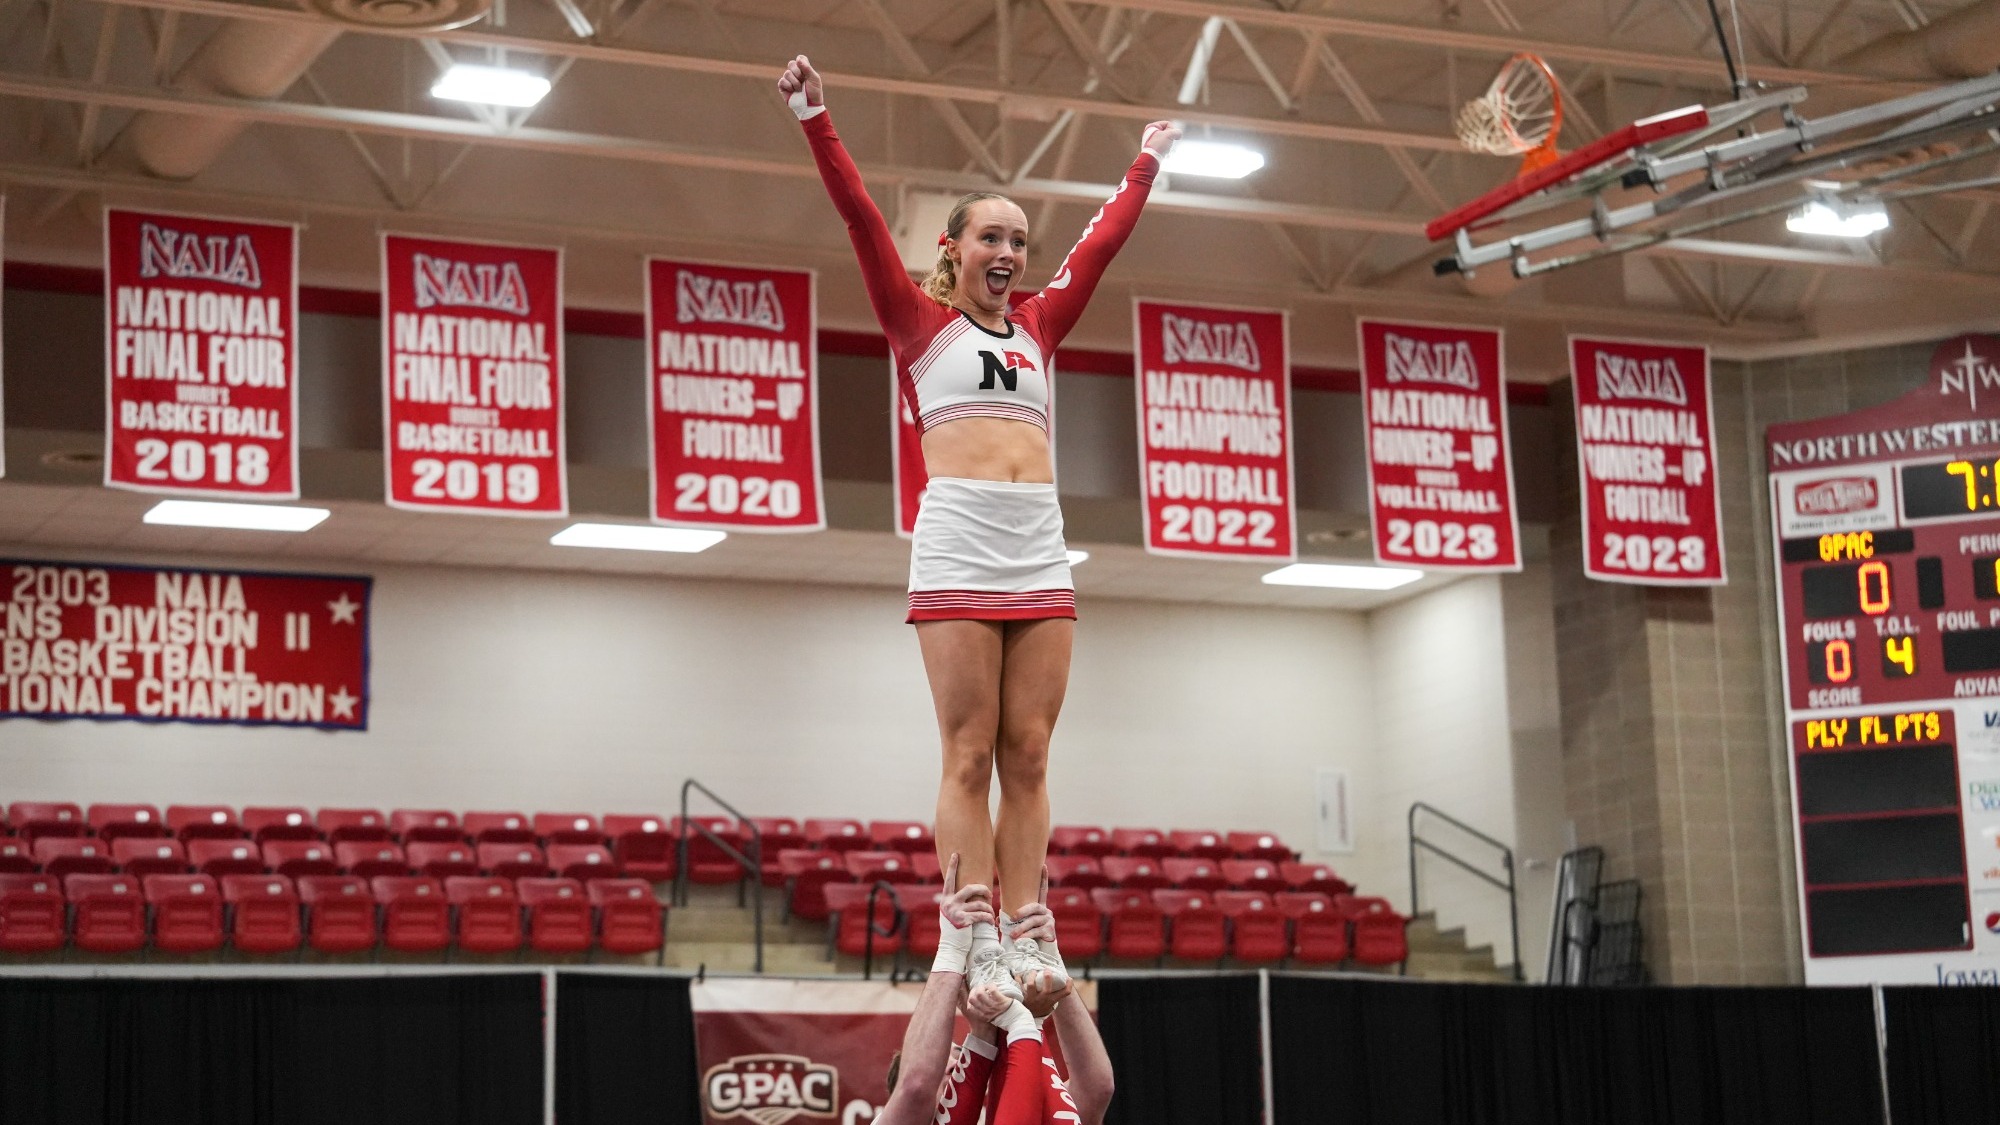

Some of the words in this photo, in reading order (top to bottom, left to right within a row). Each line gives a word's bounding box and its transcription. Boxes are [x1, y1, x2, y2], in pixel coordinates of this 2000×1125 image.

[140, 221, 262, 289] NAIA
[413, 253, 530, 316] NAIA
[676, 269, 785, 332] NAIA
[117, 286, 285, 337] NATIONAL
[117, 328, 204, 382] FINAL
[208, 334, 286, 388] FOUR
[394, 312, 551, 361] NATIONAL
[659, 330, 805, 378] NATIONAL
[1162, 312, 1261, 372] NAIA
[394, 352, 478, 406] FINAL
[479, 358, 552, 410] FOUR
[1384, 332, 1480, 391] NAIA
[1595, 350, 1688, 407] NAIA
[1145, 370, 1281, 415] NATIONAL
[1371, 389, 1496, 433] NATIONAL
[120, 399, 284, 439] BASKETBALL
[398, 421, 553, 458] BASKETBALL
[682, 418, 784, 464] FOOTBALL
[1147, 408, 1282, 458] CHAMPIONS
[1581, 405, 1703, 447] NATIONAL
[135, 437, 269, 486] 2018
[411, 457, 540, 504] 2019
[1149, 460, 1283, 506] FOOTBALL
[674, 472, 801, 518] 2020
[1376, 484, 1502, 514] VOLLEYBALL
[1604, 484, 1691, 526] FOOTBALL
[1946, 459, 2000, 511] 7:
[1160, 504, 1277, 547] 2022
[1387, 518, 1498, 560] 2023
[1603, 532, 1706, 572] 2023
[12, 566, 110, 606] 2003
[155, 571, 247, 611] NAIA
[1858, 561, 1890, 615] 0
[95, 605, 259, 649] DIVISION
[285, 612, 310, 651] II
[1803, 620, 1856, 643] FOULS
[1873, 615, 1920, 636] T.O.L.
[1937, 610, 1980, 632] FOUL
[3, 638, 258, 682] BASKETBALL
[1825, 639, 1851, 683] 0
[1886, 636, 1914, 675] 4
[135, 677, 324, 722] CHAMPION
[1808, 686, 1862, 709] SCORE
[1806, 718, 1848, 749] PLY
[1860, 715, 1889, 745] FL
[1895, 711, 1940, 742] PTS
[710, 1072, 830, 1110] GPAC
